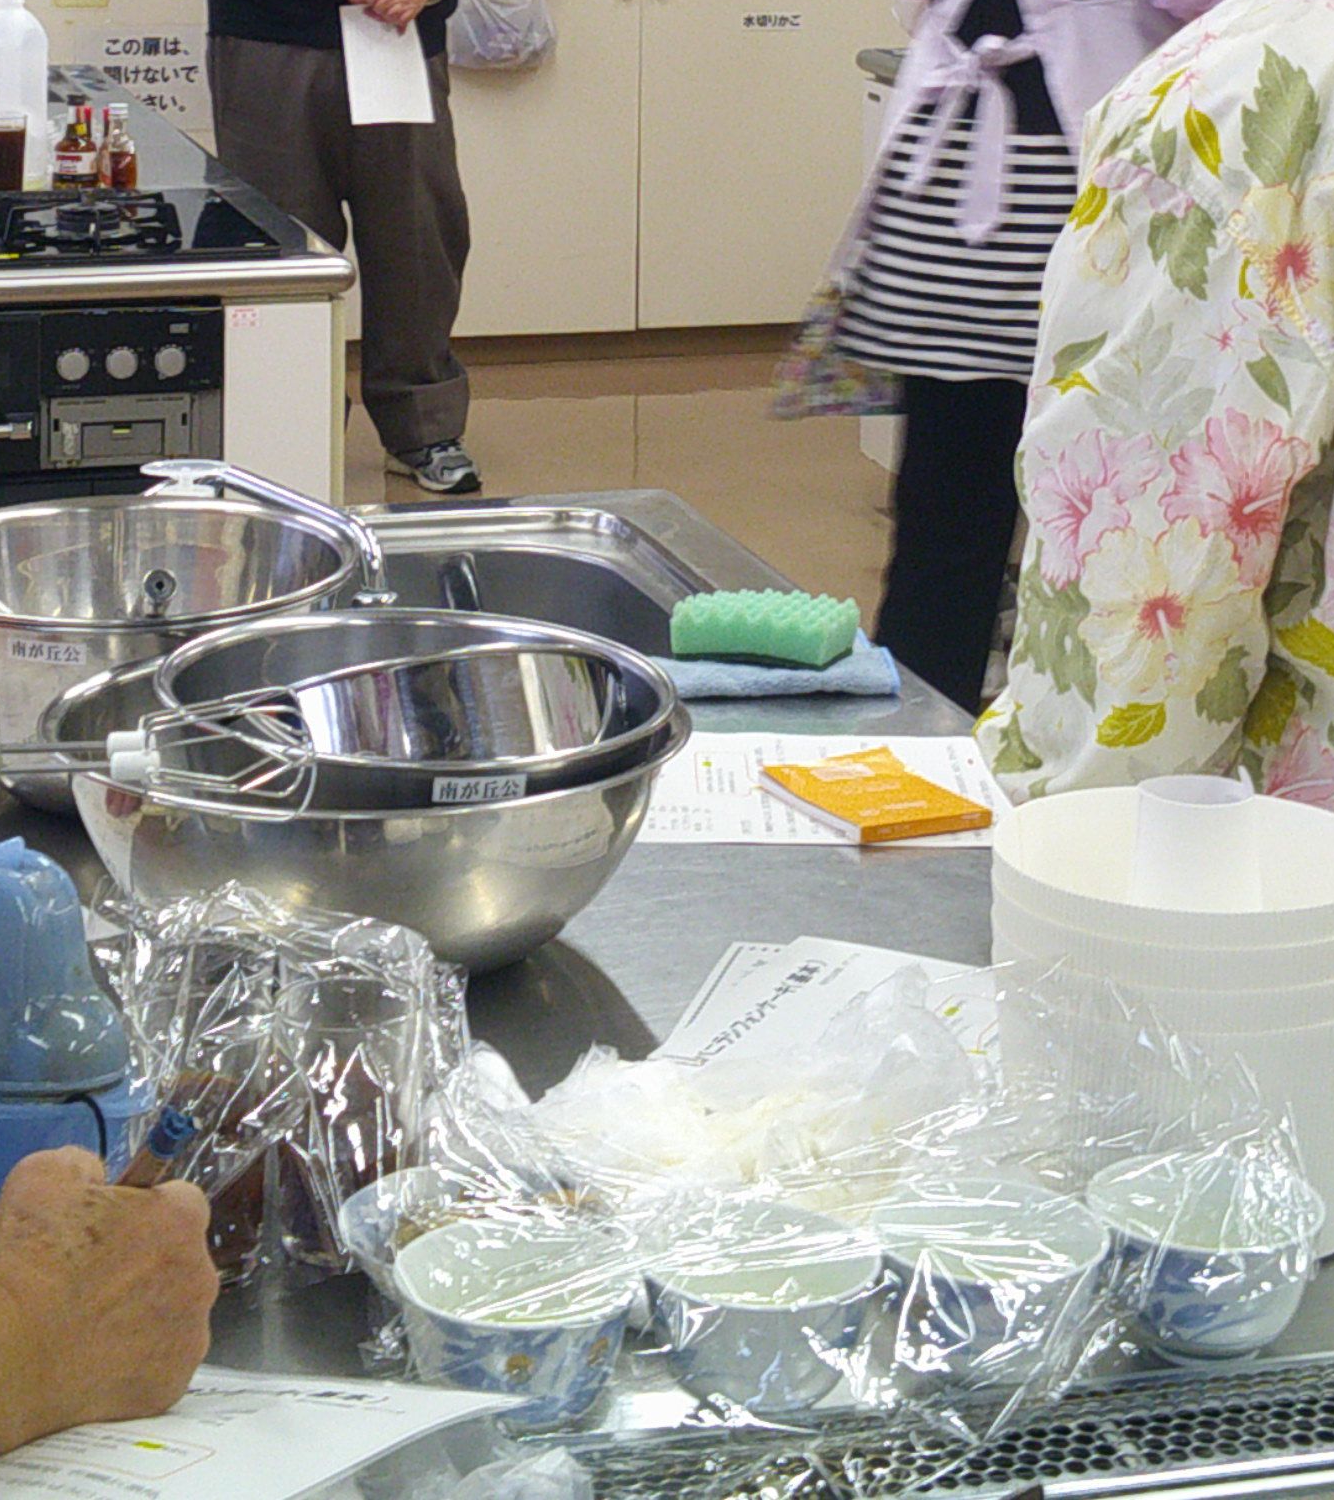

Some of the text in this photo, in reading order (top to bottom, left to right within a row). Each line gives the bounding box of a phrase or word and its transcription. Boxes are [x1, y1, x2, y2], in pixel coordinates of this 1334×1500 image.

[743, 14, 802, 28] 水切りかご
[105, 37, 190, 56] この扉は、
[12, 640, 81, 662] 南が丘公
[439, 779, 520, 800] 南が丘公
